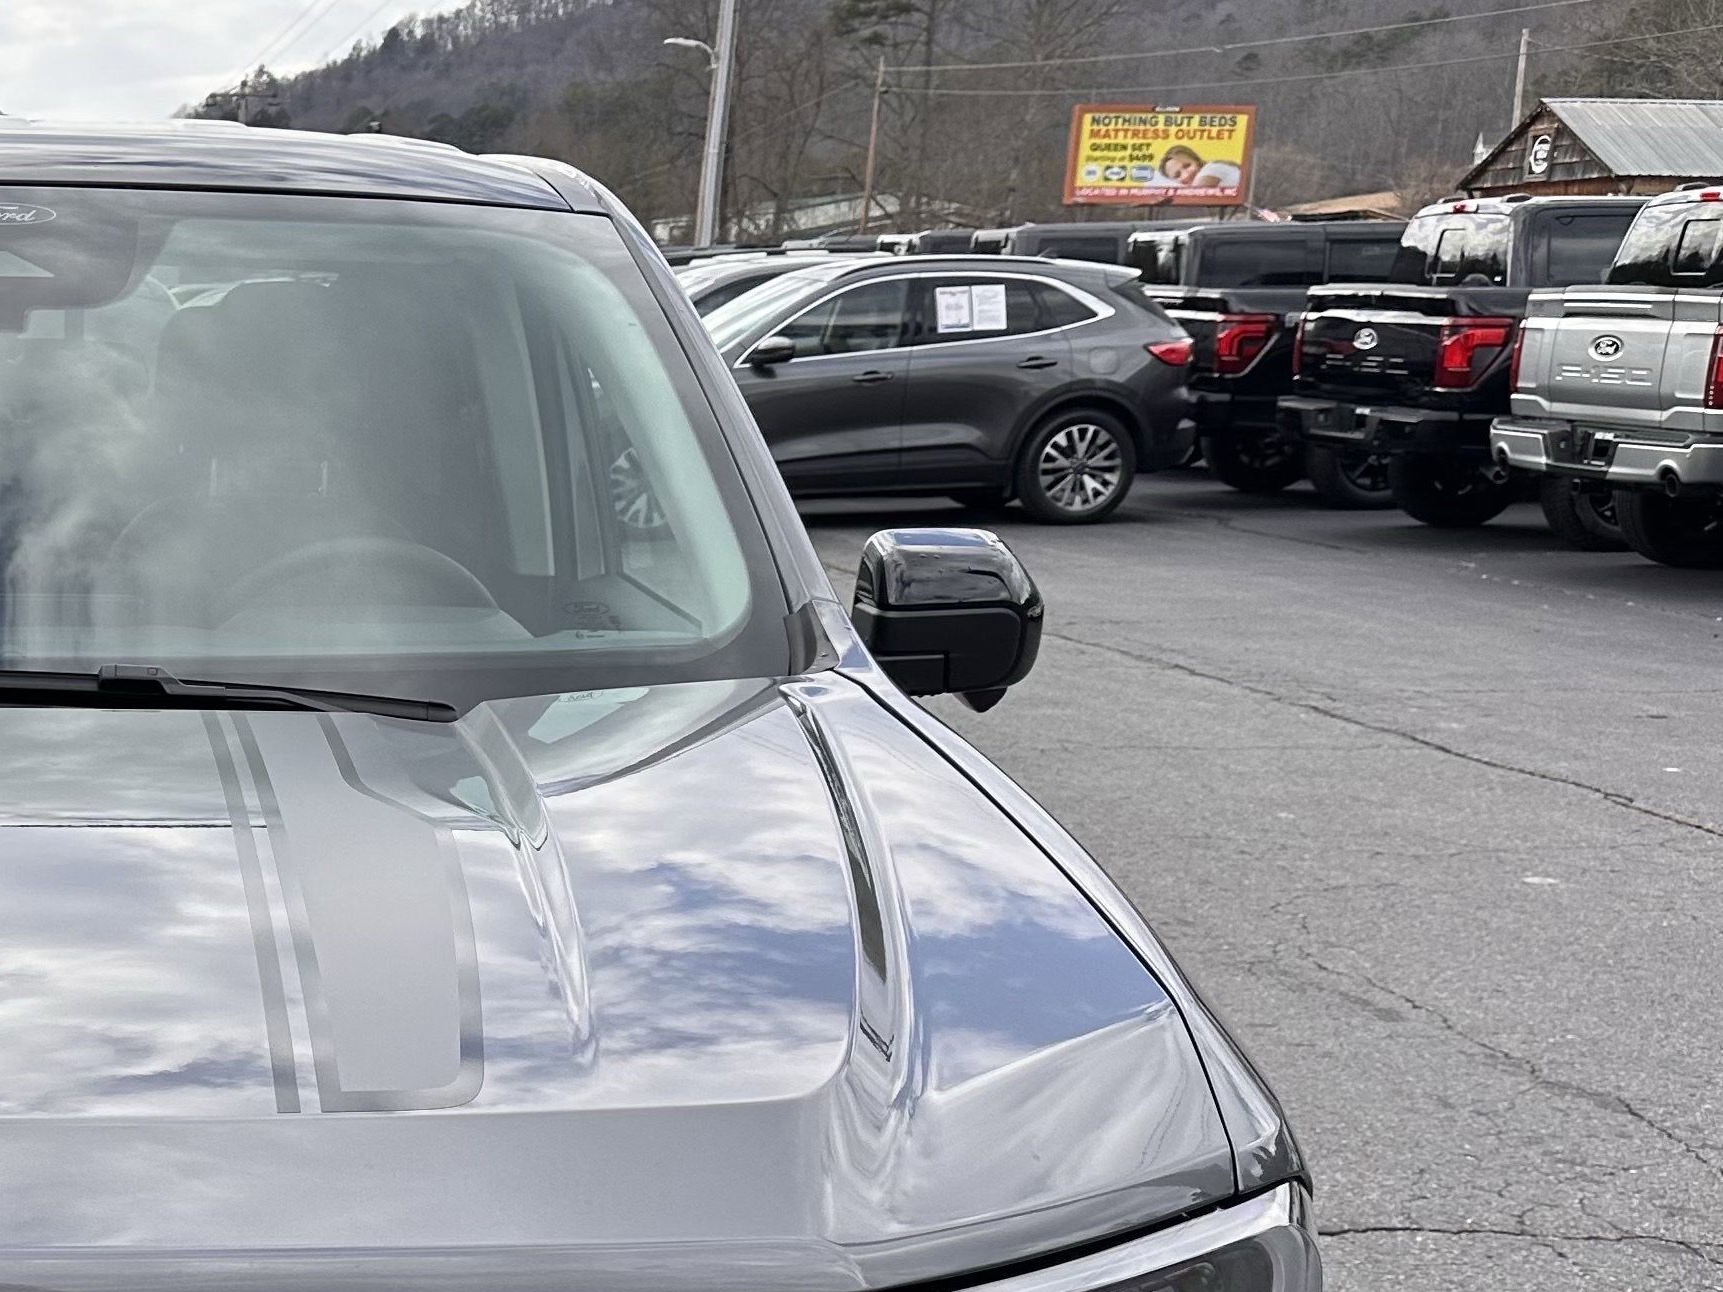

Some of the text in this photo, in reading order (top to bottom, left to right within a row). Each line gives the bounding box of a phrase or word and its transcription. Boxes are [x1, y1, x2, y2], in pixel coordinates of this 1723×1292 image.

[1090, 115, 1238, 127] NOTHING BUT BEDS
[1089, 128, 1236, 140] MATTRESS OUTLET
[1089, 142, 1152, 152] QUEEN SET
